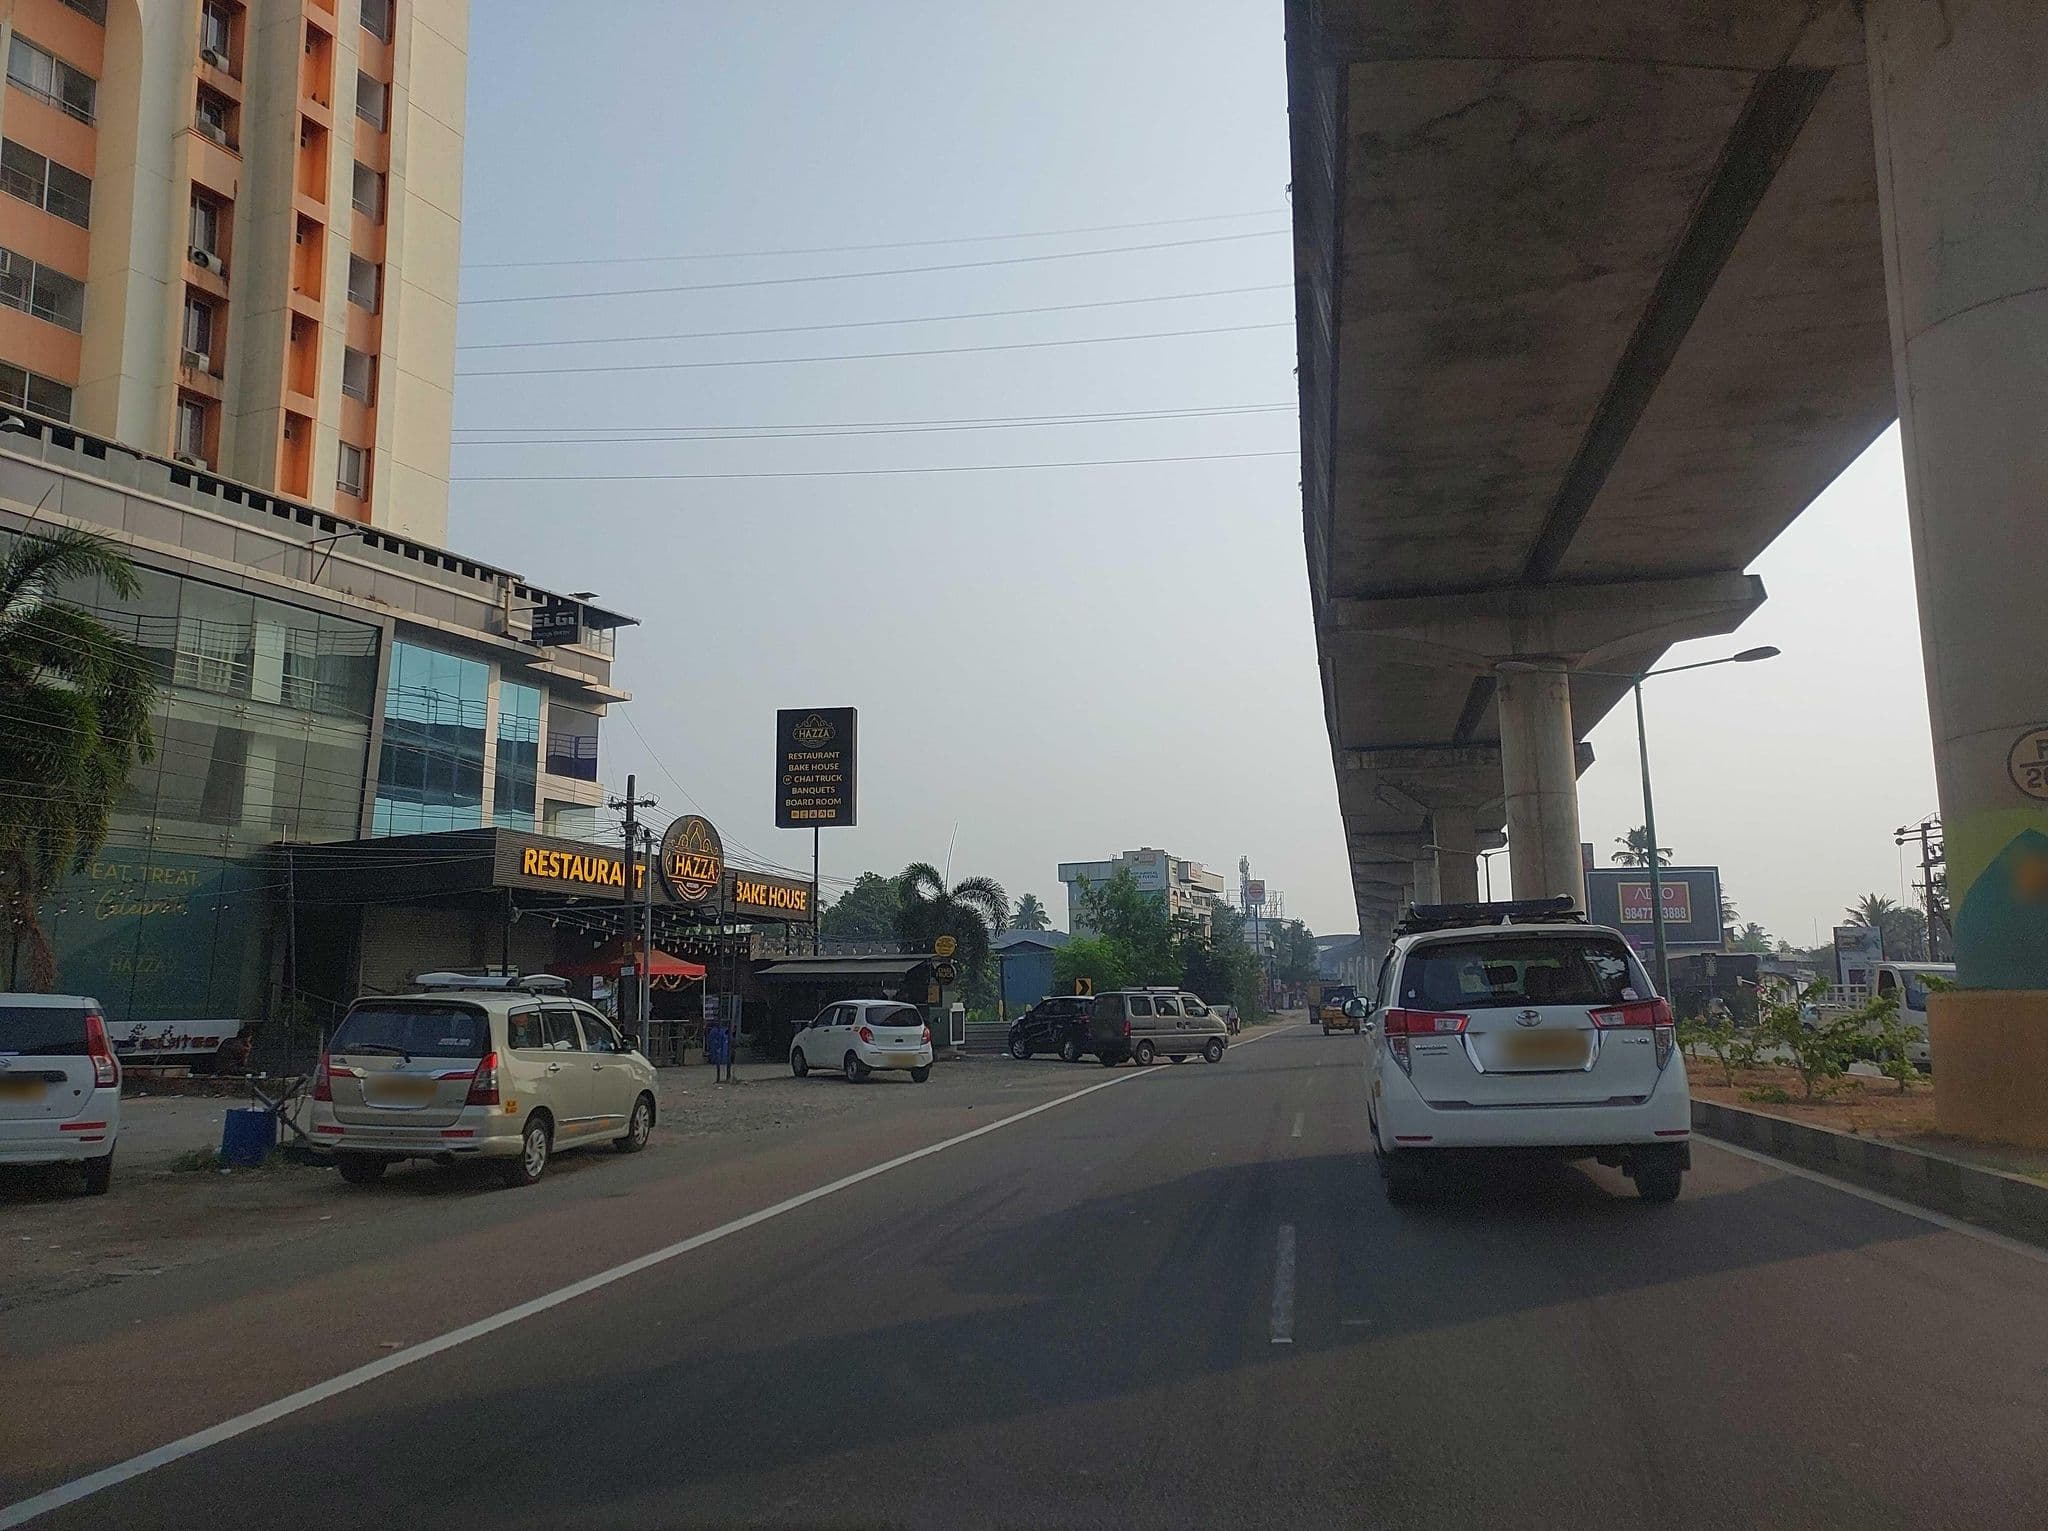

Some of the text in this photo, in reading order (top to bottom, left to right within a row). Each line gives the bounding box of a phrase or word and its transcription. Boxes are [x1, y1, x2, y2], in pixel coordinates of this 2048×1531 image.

[799, 729, 830, 738] HAZZA
[788, 752, 840, 760] RESTAURANT
[816, 774, 842, 782] TRUCK
[791, 786, 836, 794] BANQUETS
[675, 854, 715, 880] HAZZA
[736, 881, 807, 910] BAKE HOUSE
